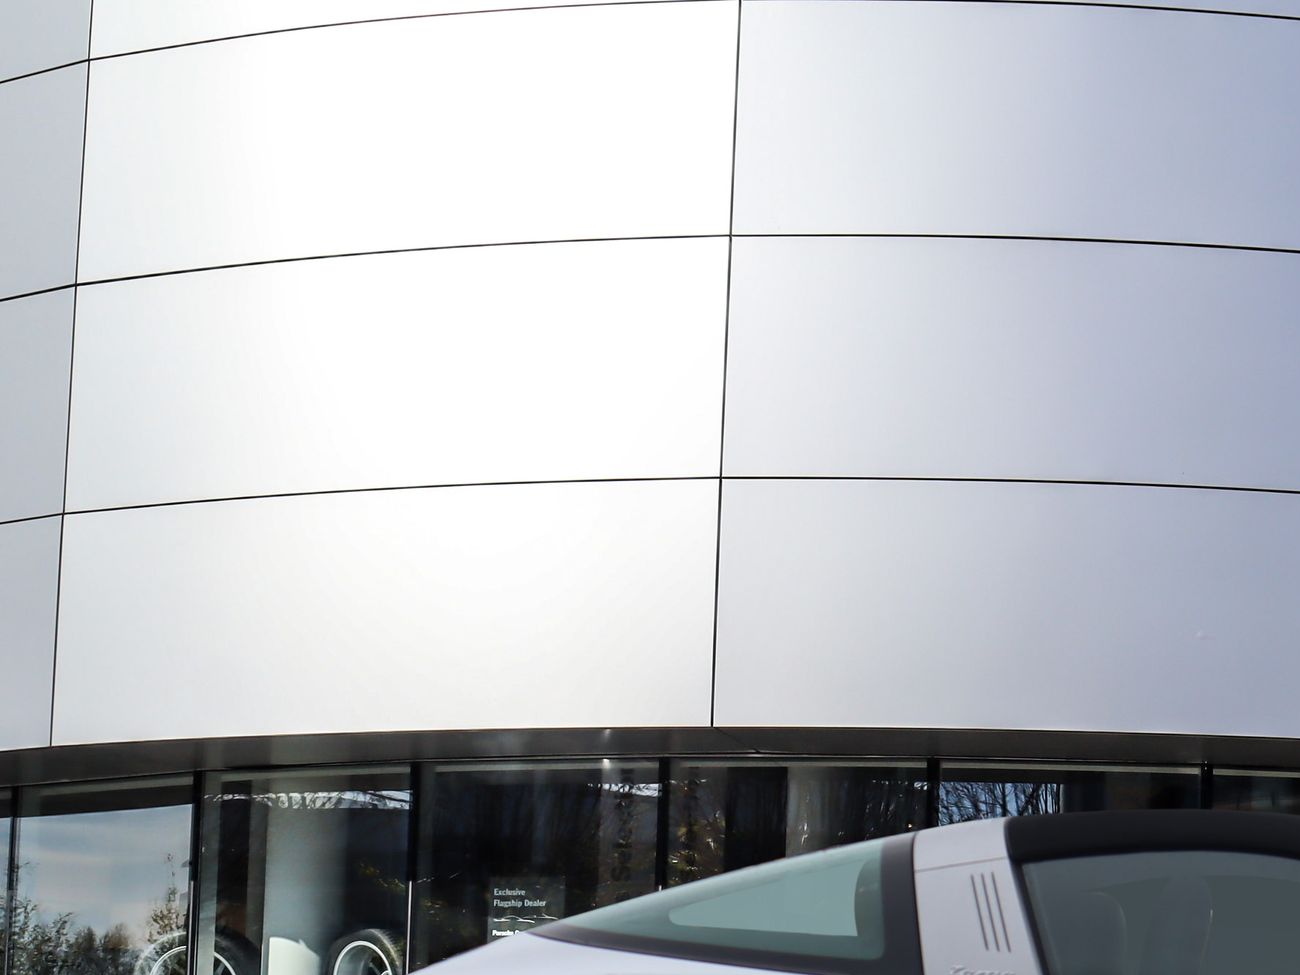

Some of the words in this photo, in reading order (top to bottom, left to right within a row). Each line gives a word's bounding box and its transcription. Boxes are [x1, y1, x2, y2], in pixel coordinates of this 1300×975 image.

[493, 888, 526, 896] Exclusive
[493, 899, 523, 908] Flagship
[524, 899, 546, 907] Dealer
